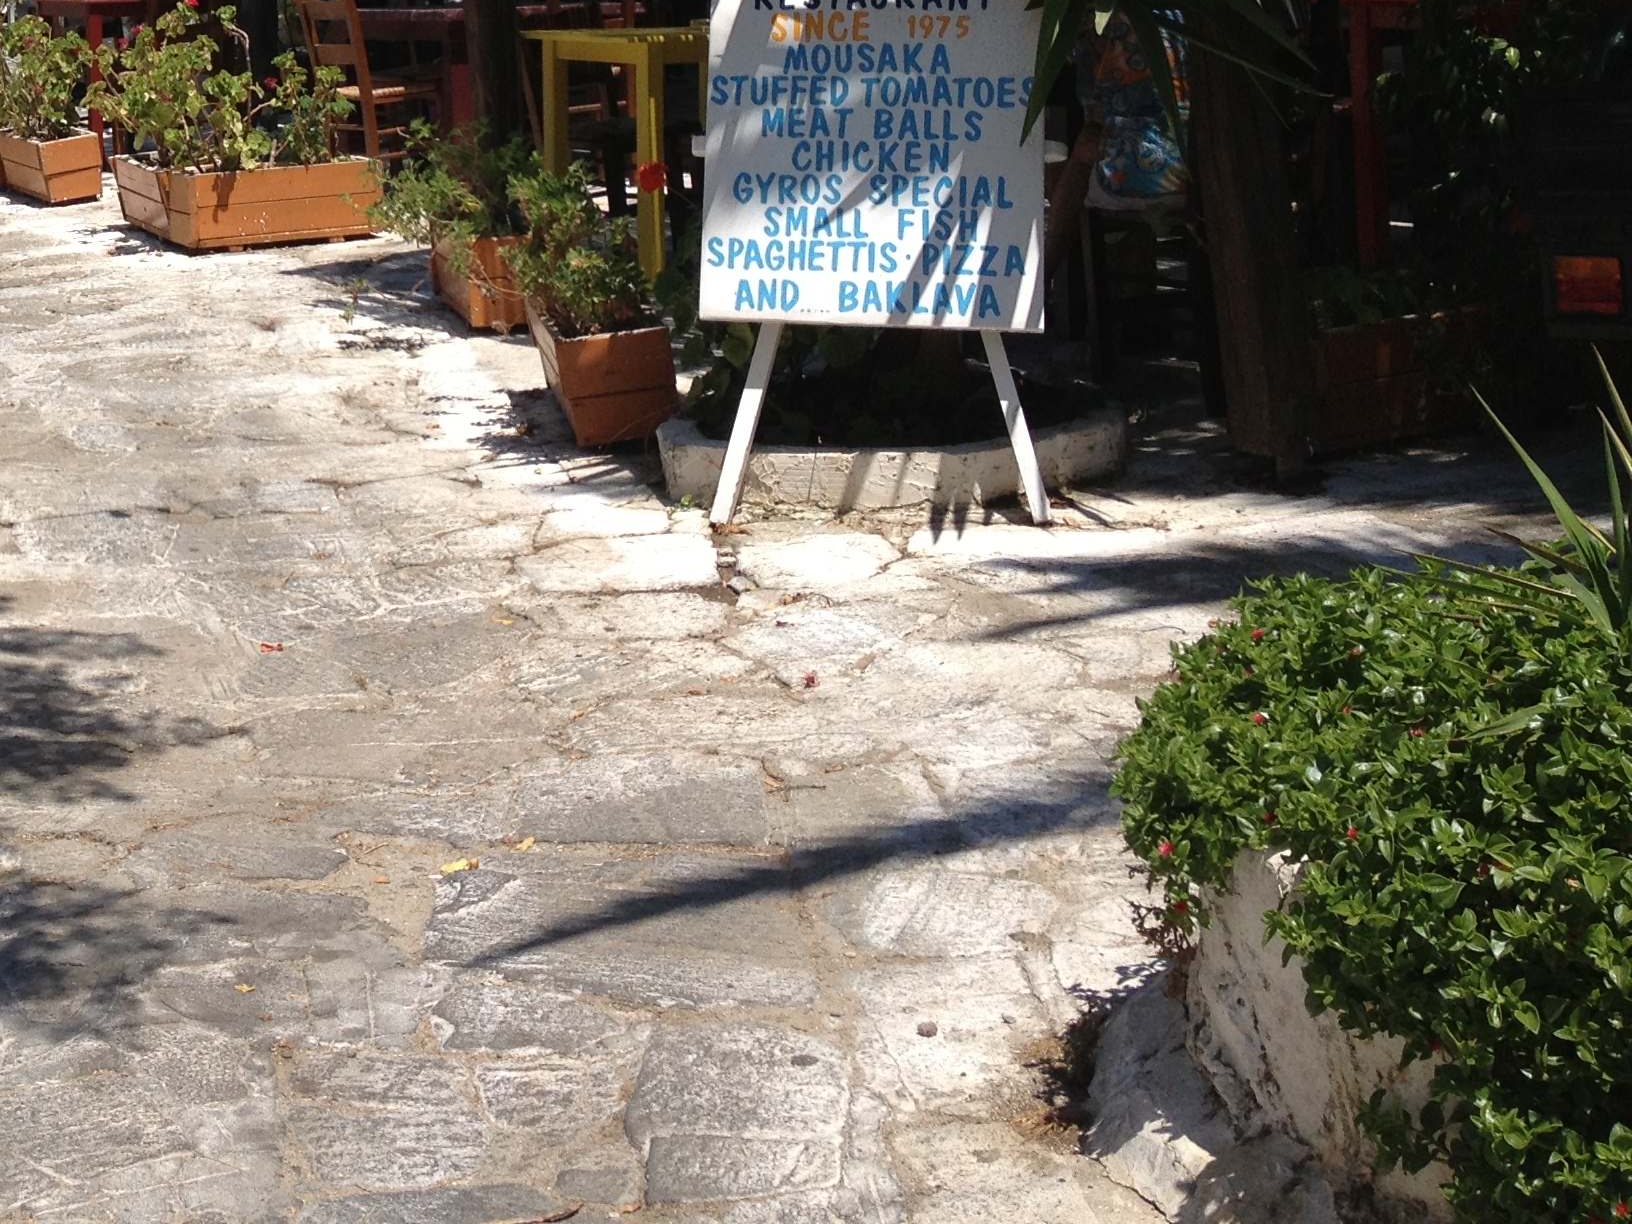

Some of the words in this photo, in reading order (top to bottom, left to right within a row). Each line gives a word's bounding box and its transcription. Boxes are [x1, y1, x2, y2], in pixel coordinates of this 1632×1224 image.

[770, 11, 870, 42] SINCE
[907, 14, 971, 40] 1975
[783, 42, 951, 74] MOUSAKA
[710, 75, 849, 107] STUFFED
[859, 76, 1034, 110] TOMATOES
[761, 108, 853, 139] MEAT
[873, 111, 984, 142] BALLS
[791, 140, 950, 174] CHICKEN
[732, 172, 843, 205] GYROS
[869, 174, 1014, 209] SPECIAL
[764, 206, 869, 239] SMALL
[897, 209, 979, 243] FISH
[706, 237, 898, 274] SPAGHETTIS
[922, 243, 1026, 278] PIZZA
[734, 278, 800, 313] AND
[838, 279, 1002, 319] BAKLAVA
